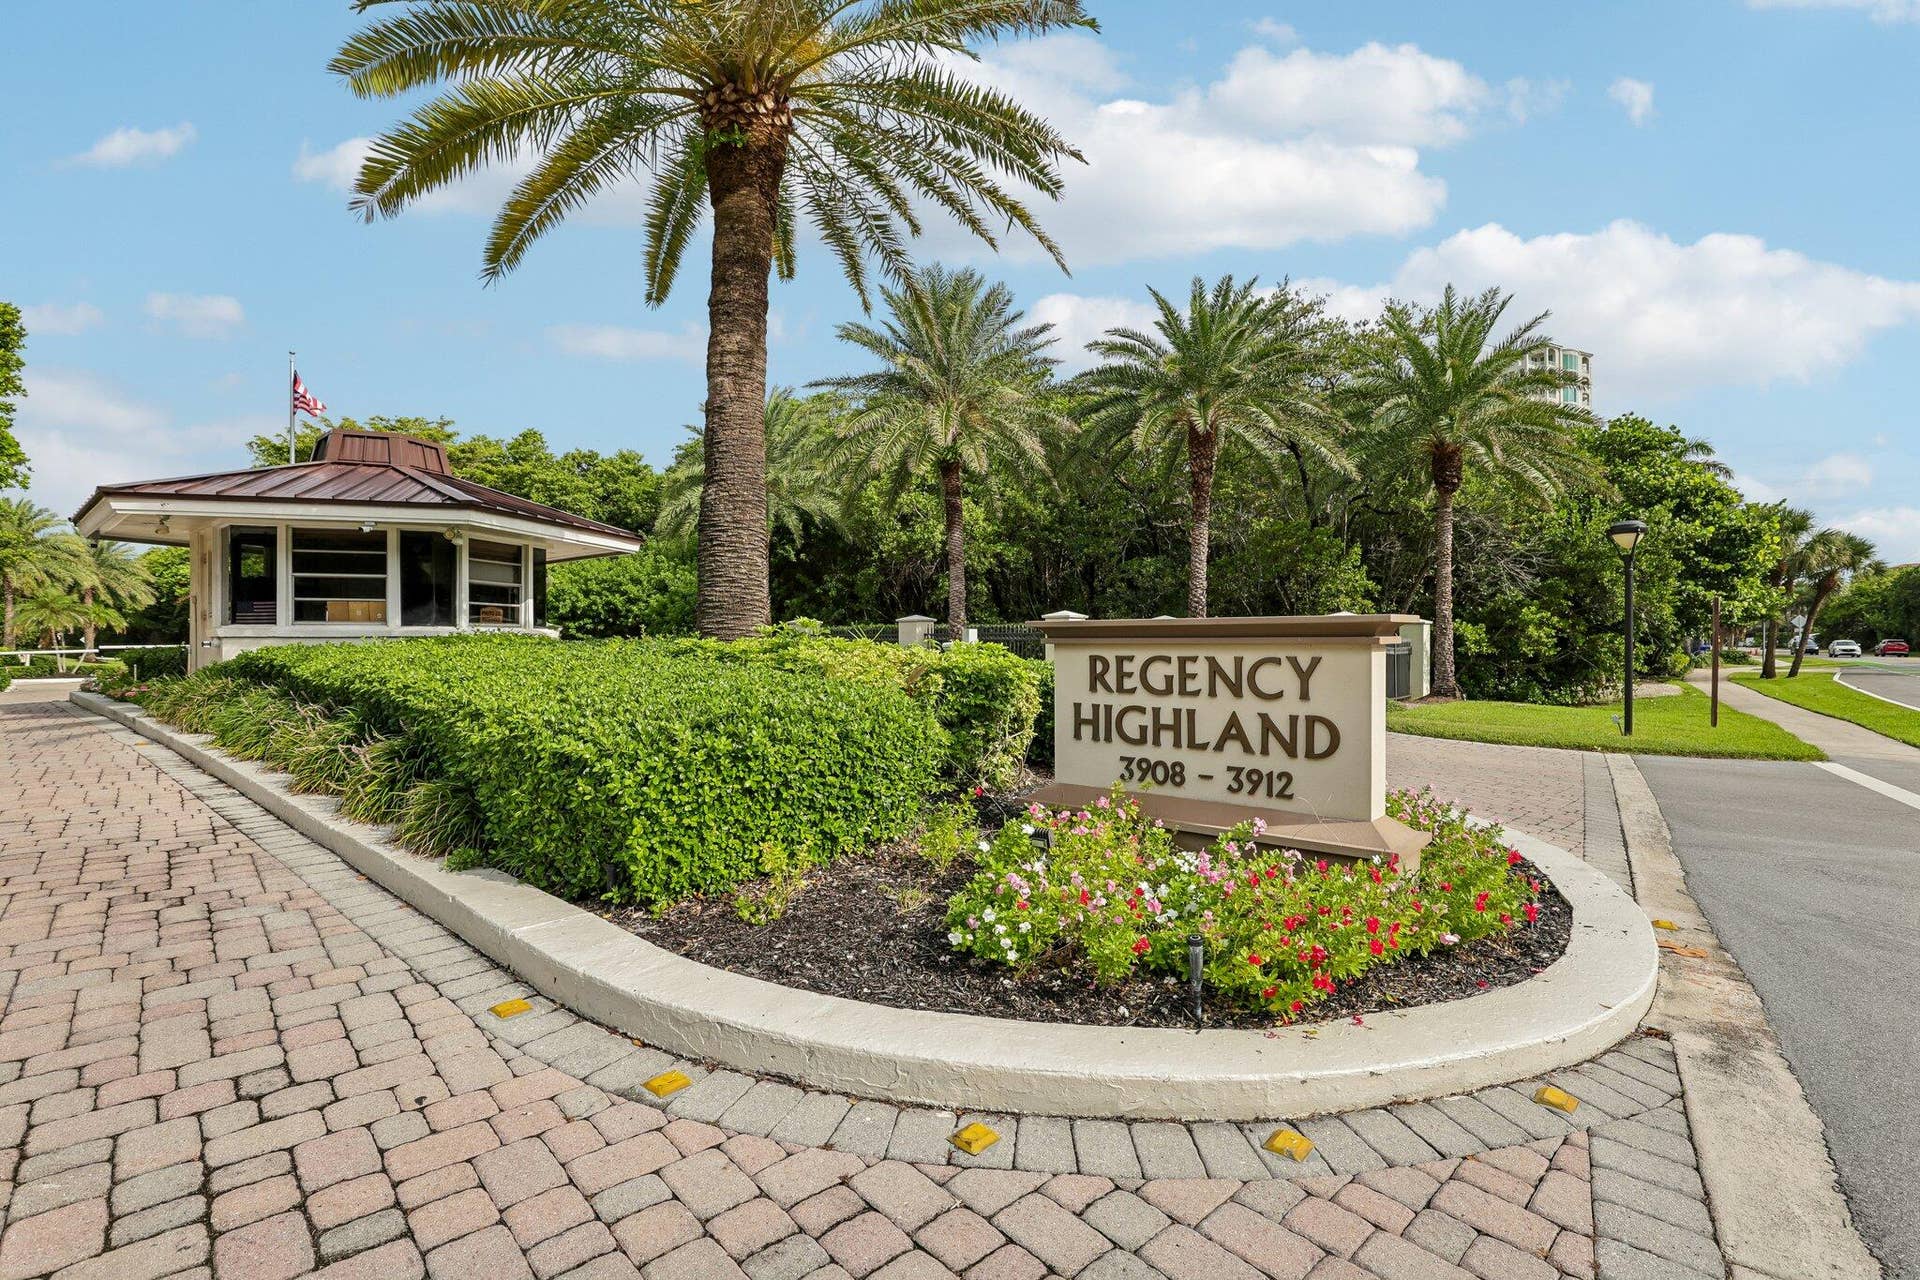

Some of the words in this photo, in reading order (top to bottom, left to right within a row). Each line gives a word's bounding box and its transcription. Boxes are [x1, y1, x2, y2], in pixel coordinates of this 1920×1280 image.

[1088, 654, 1323, 701] REGENCY
[1072, 702, 1342, 760] HIGHLAND
[1119, 755, 1186, 788] 3908
[1226, 765, 1295, 800] 3912
